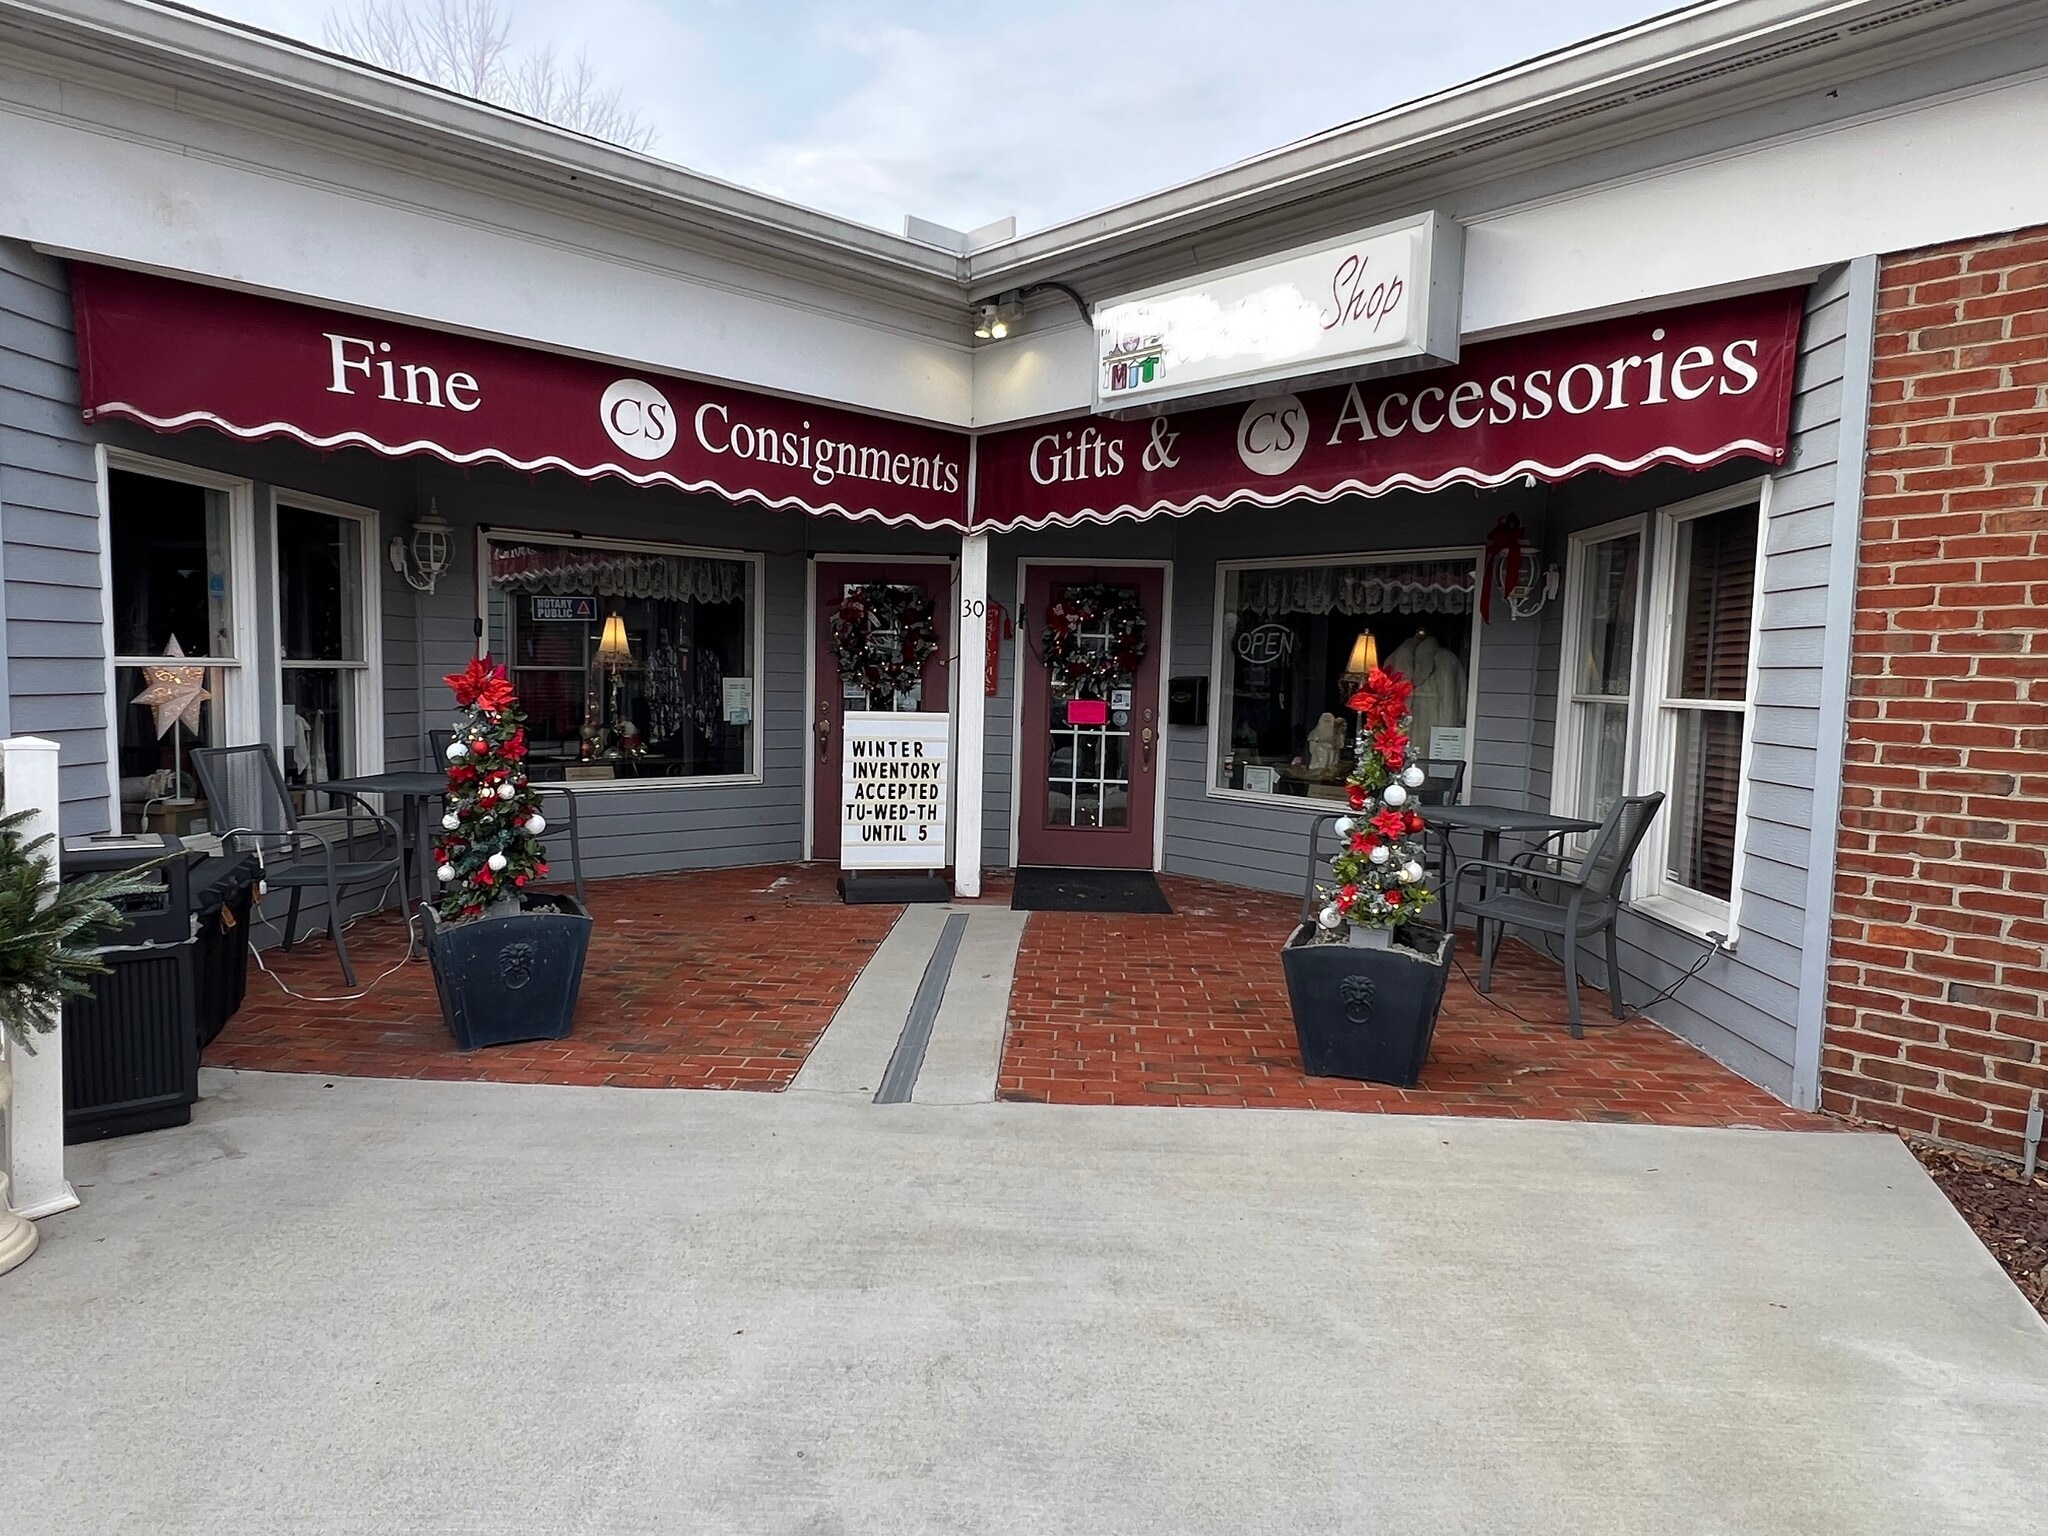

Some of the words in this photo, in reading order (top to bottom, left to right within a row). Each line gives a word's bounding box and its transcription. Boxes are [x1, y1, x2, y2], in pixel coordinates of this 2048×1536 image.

[1323, 254, 1404, 333] Shop
[322, 332, 482, 412] Fine
[1326, 327, 1760, 446] Accessories
[609, 398, 667, 441] CS
[1243, 407, 1301, 455] CS
[694, 402, 960, 494] Consignments
[1029, 426, 1125, 486] Gifts
[1141, 415, 1181, 472] &
[536, 598, 573, 608] NOTARY
[537, 608, 573, 618] PUBLIC
[962, 599, 985, 618] 30
[1237, 632, 1294, 655] OPEN
[852, 740, 924, 758] WINTER
[852, 762, 941, 779] INVENTORY
[854, 783, 939, 800] ACCEPTED
[846, 804, 937, 821] TU-WED-TH
[862, 825, 907, 842] UNTIL
[918, 825, 928, 841] 5
